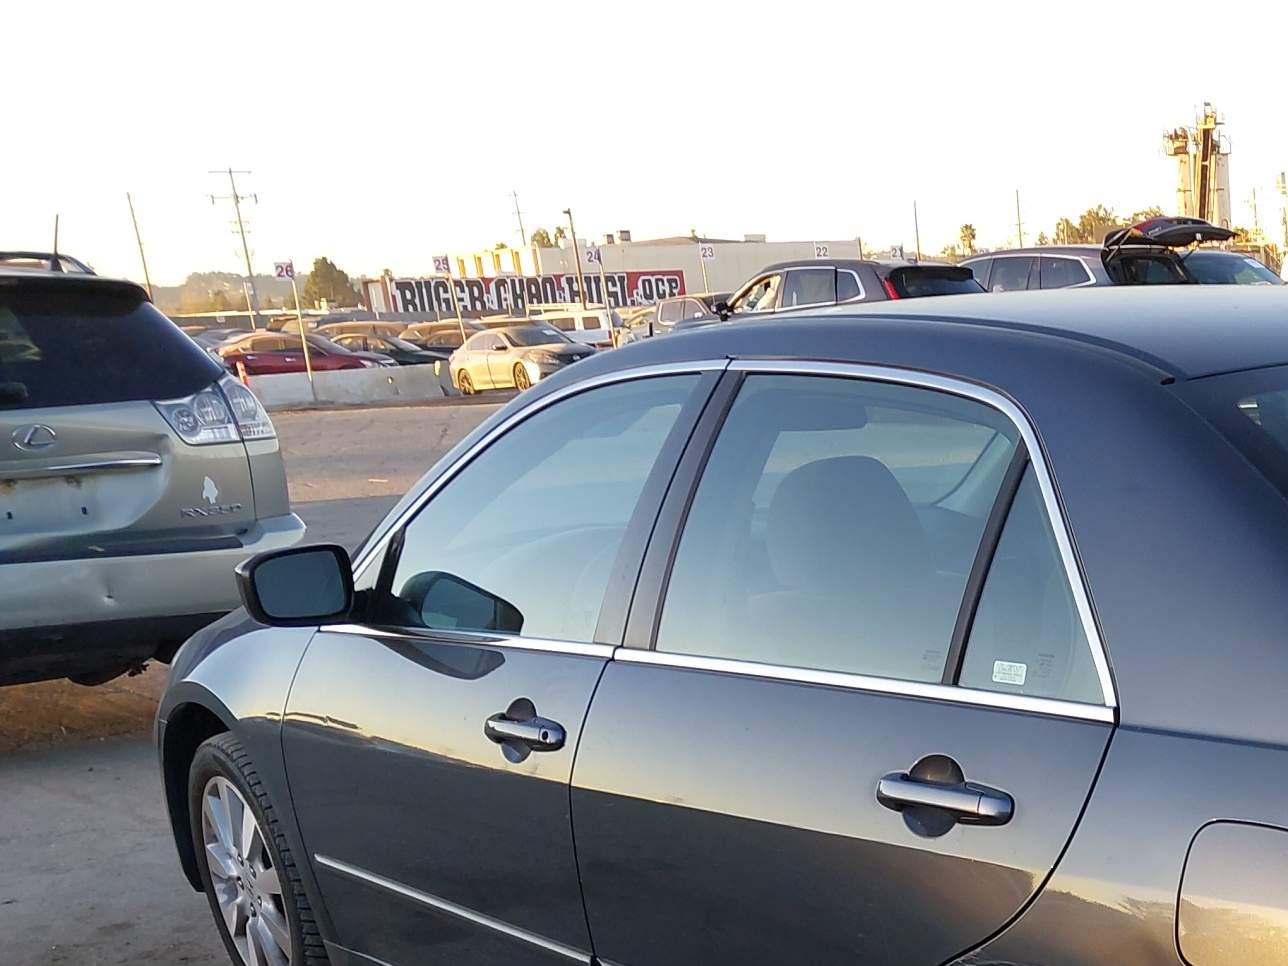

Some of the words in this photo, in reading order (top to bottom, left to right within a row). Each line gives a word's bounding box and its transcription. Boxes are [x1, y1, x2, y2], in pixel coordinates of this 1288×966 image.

[586, 250, 601, 263] 24
[700, 246, 714, 258] 23
[815, 246, 828, 258] 22
[275, 264, 294, 278] 26
